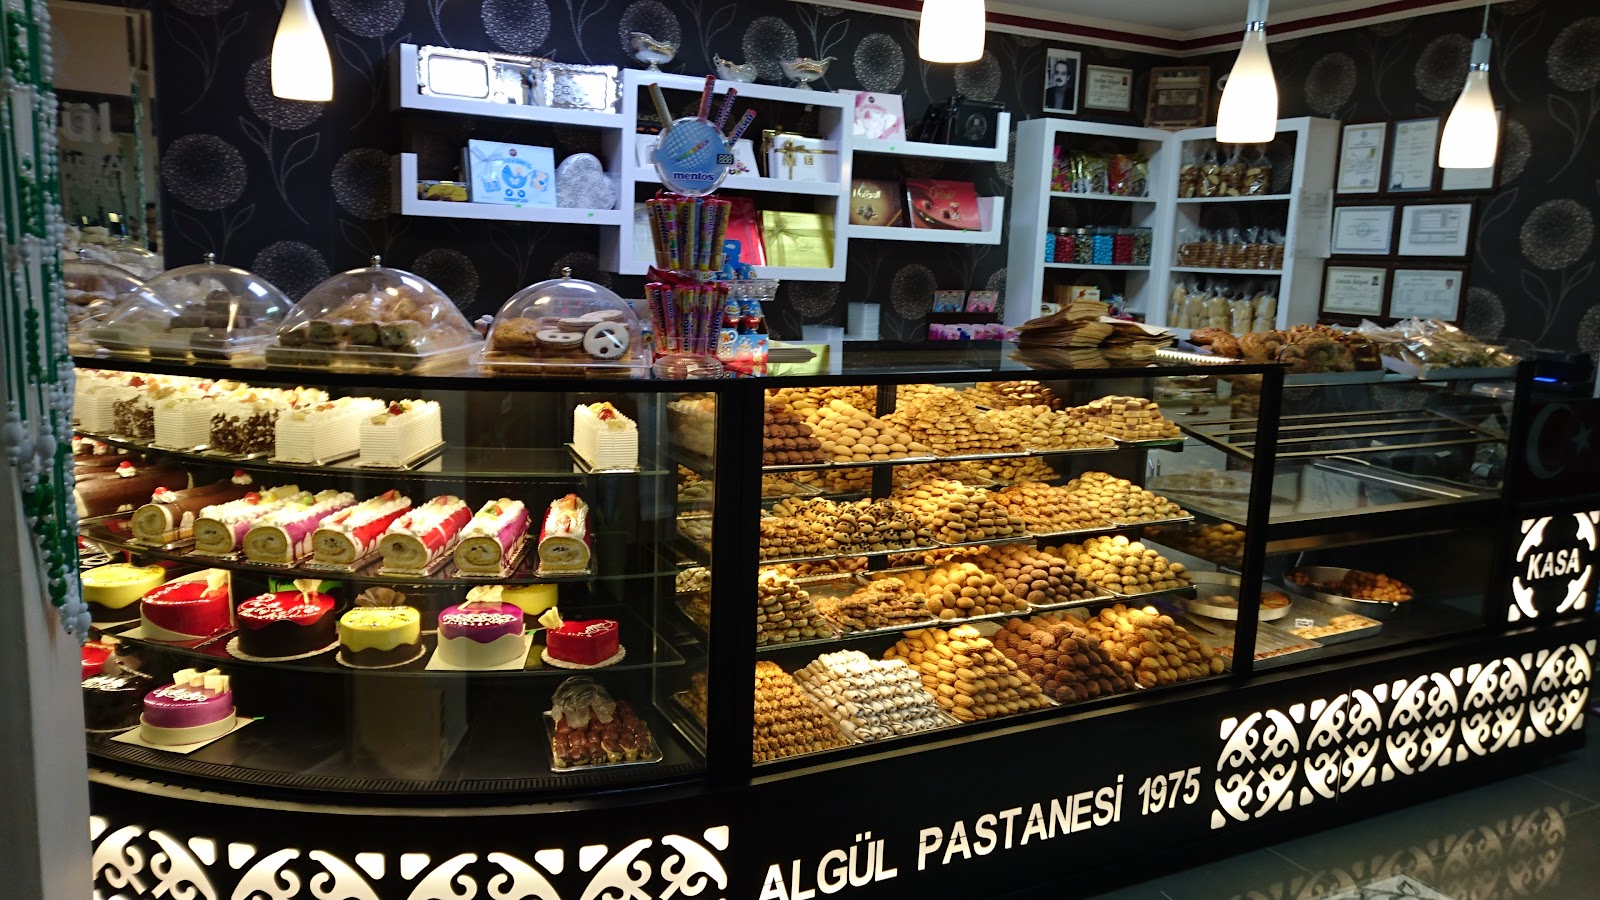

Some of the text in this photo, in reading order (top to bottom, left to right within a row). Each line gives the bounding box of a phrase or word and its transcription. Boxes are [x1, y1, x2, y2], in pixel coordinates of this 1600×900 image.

[729, 113, 753, 147] mentos
[673, 171, 715, 181] mentos
[683, 312, 691, 351] mentos
[710, 310, 723, 351] mentos
[1526, 547, 1580, 581] KASA
[758, 767, 1201, 900] ALGÜL PASTANESİ 1975
